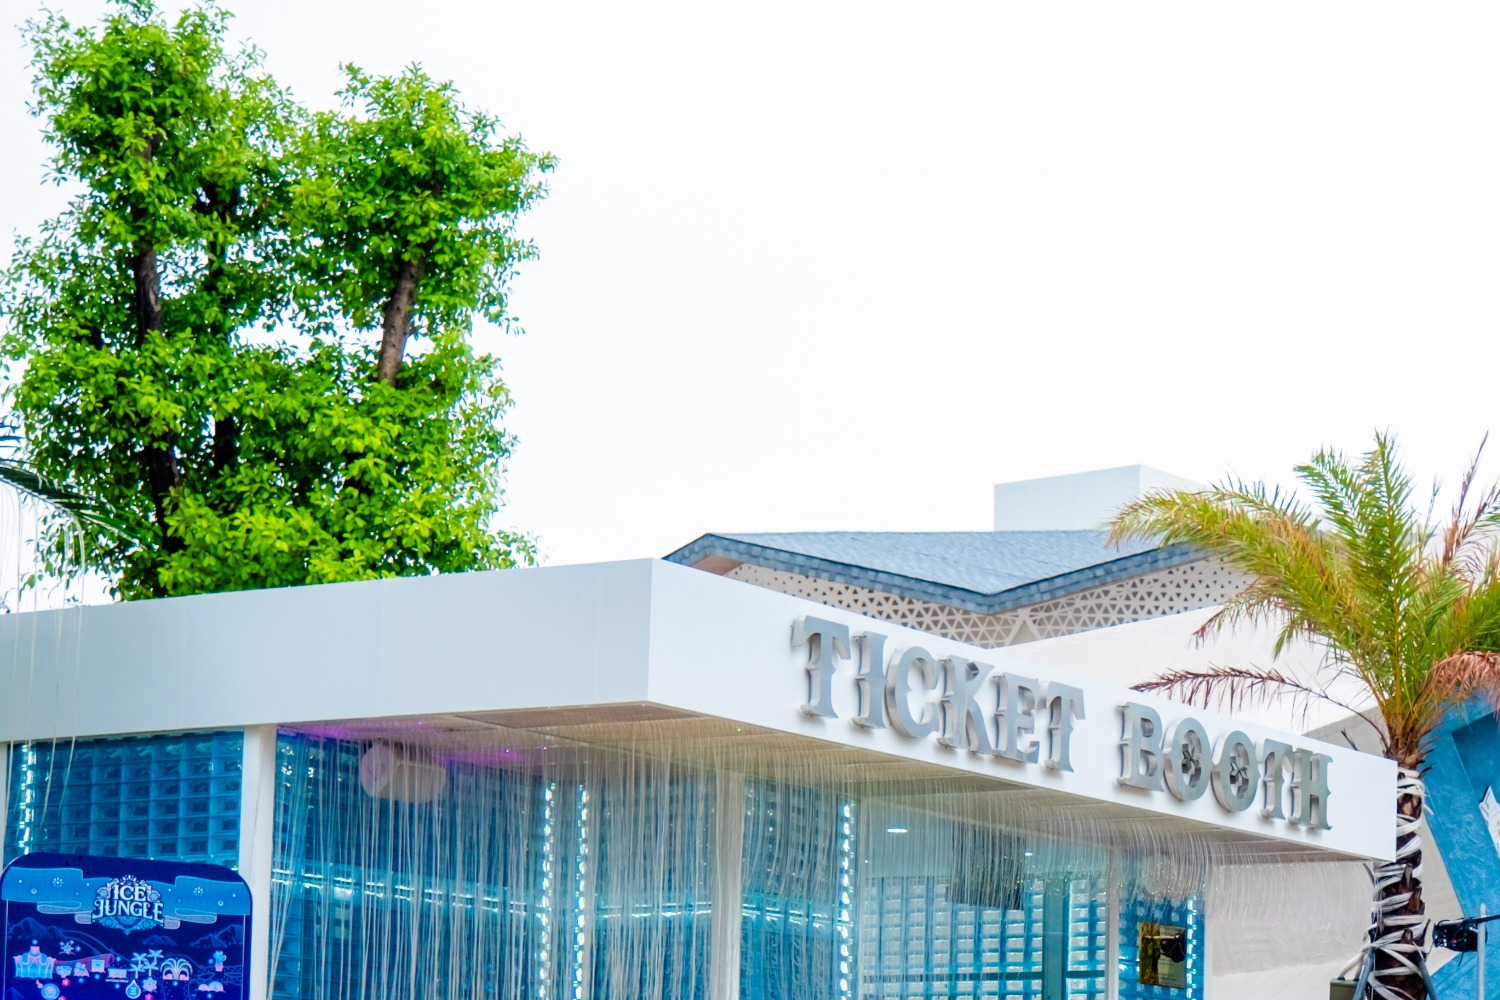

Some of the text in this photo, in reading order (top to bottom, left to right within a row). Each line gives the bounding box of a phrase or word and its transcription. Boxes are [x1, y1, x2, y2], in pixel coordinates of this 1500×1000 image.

[792, 614, 1332, 831] TICKET BOOTH
[113, 884, 146, 901] ICE
[92, 899, 164, 924] JUNGLE
